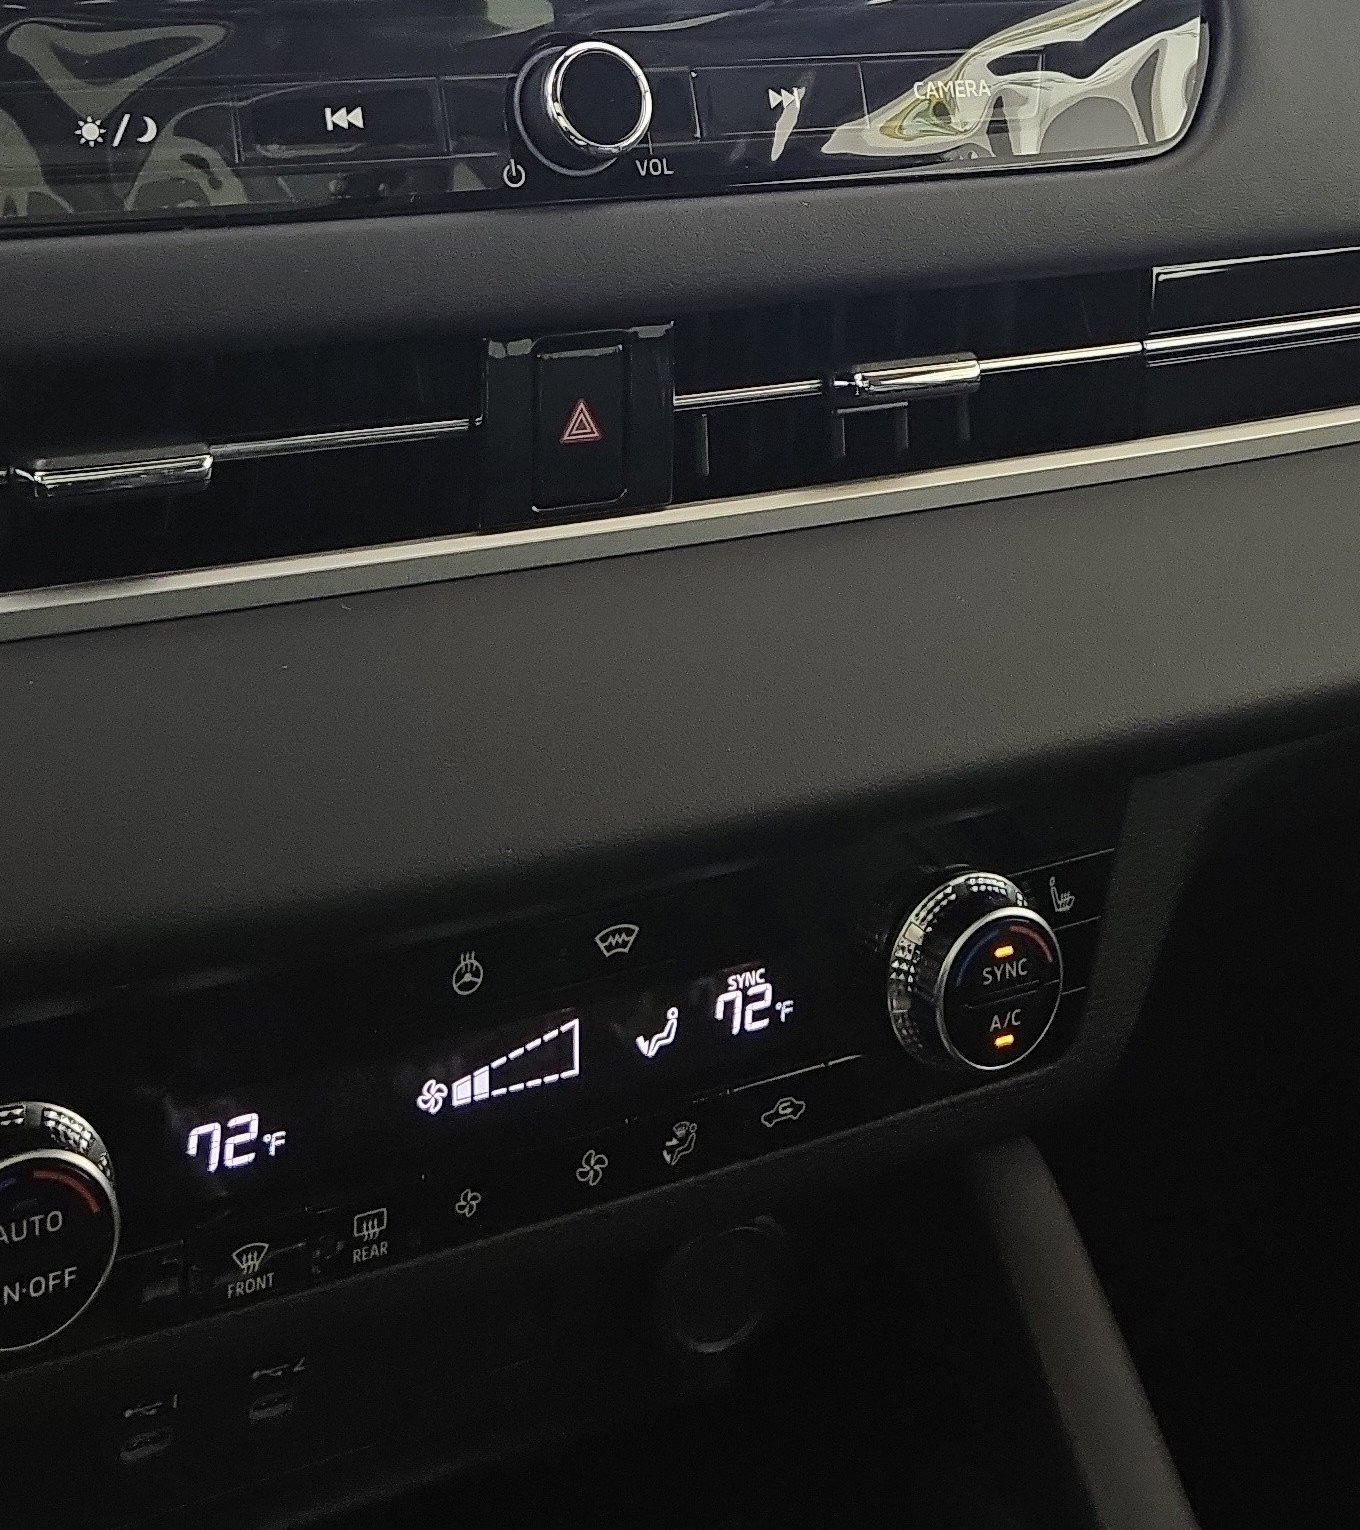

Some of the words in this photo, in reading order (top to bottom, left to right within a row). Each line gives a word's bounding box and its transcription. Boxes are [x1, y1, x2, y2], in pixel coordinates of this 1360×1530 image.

[913, 78, 992, 104] CAMERA
[633, 156, 675, 177] VOL
[726, 967, 767, 991] SYNC
[981, 958, 1029, 986] SYNC
[989, 1008, 1023, 1033] A/C
[352, 1241, 389, 1264] REAR
[227, 1272, 275, 1299] FRONT
